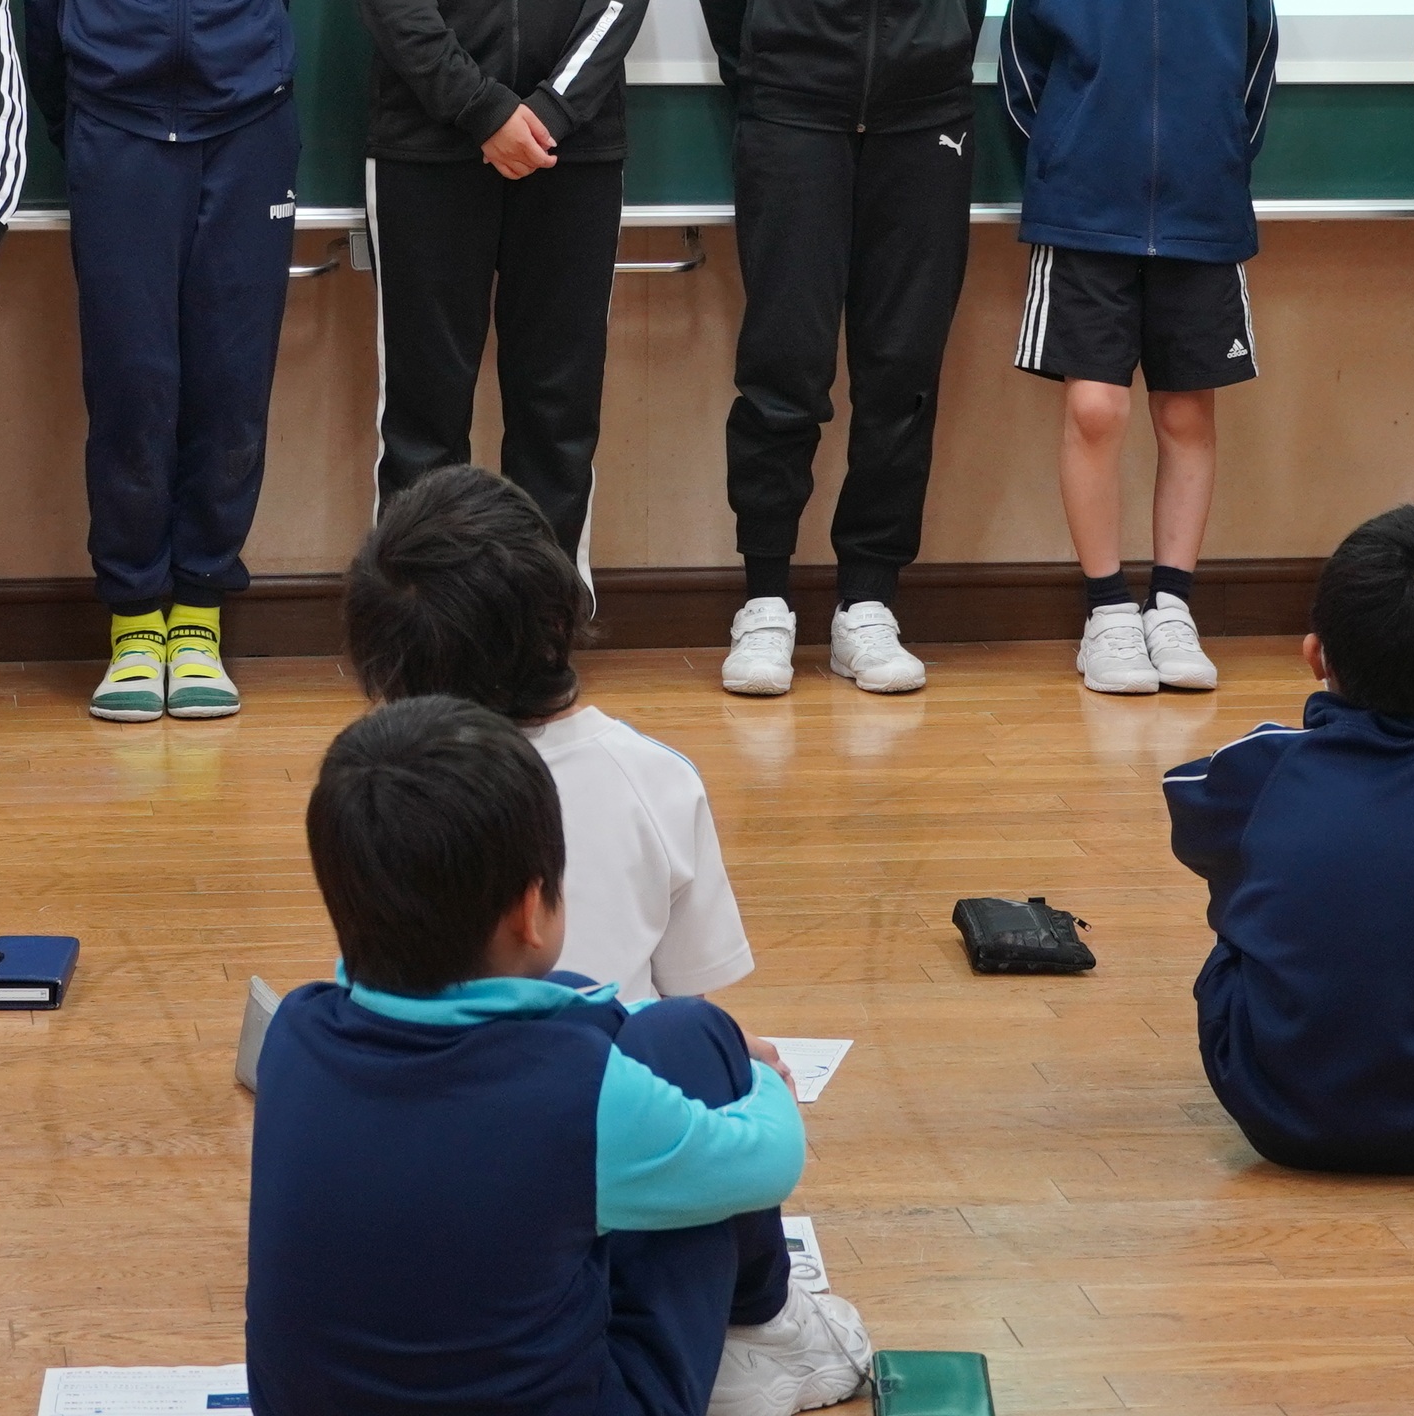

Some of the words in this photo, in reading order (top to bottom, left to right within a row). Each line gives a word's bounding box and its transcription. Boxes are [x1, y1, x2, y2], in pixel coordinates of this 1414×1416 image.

[589, 15, 613, 43] PUMA
[1227, 348, 1248, 359] adidas
[170, 628, 214, 639] PUMA
